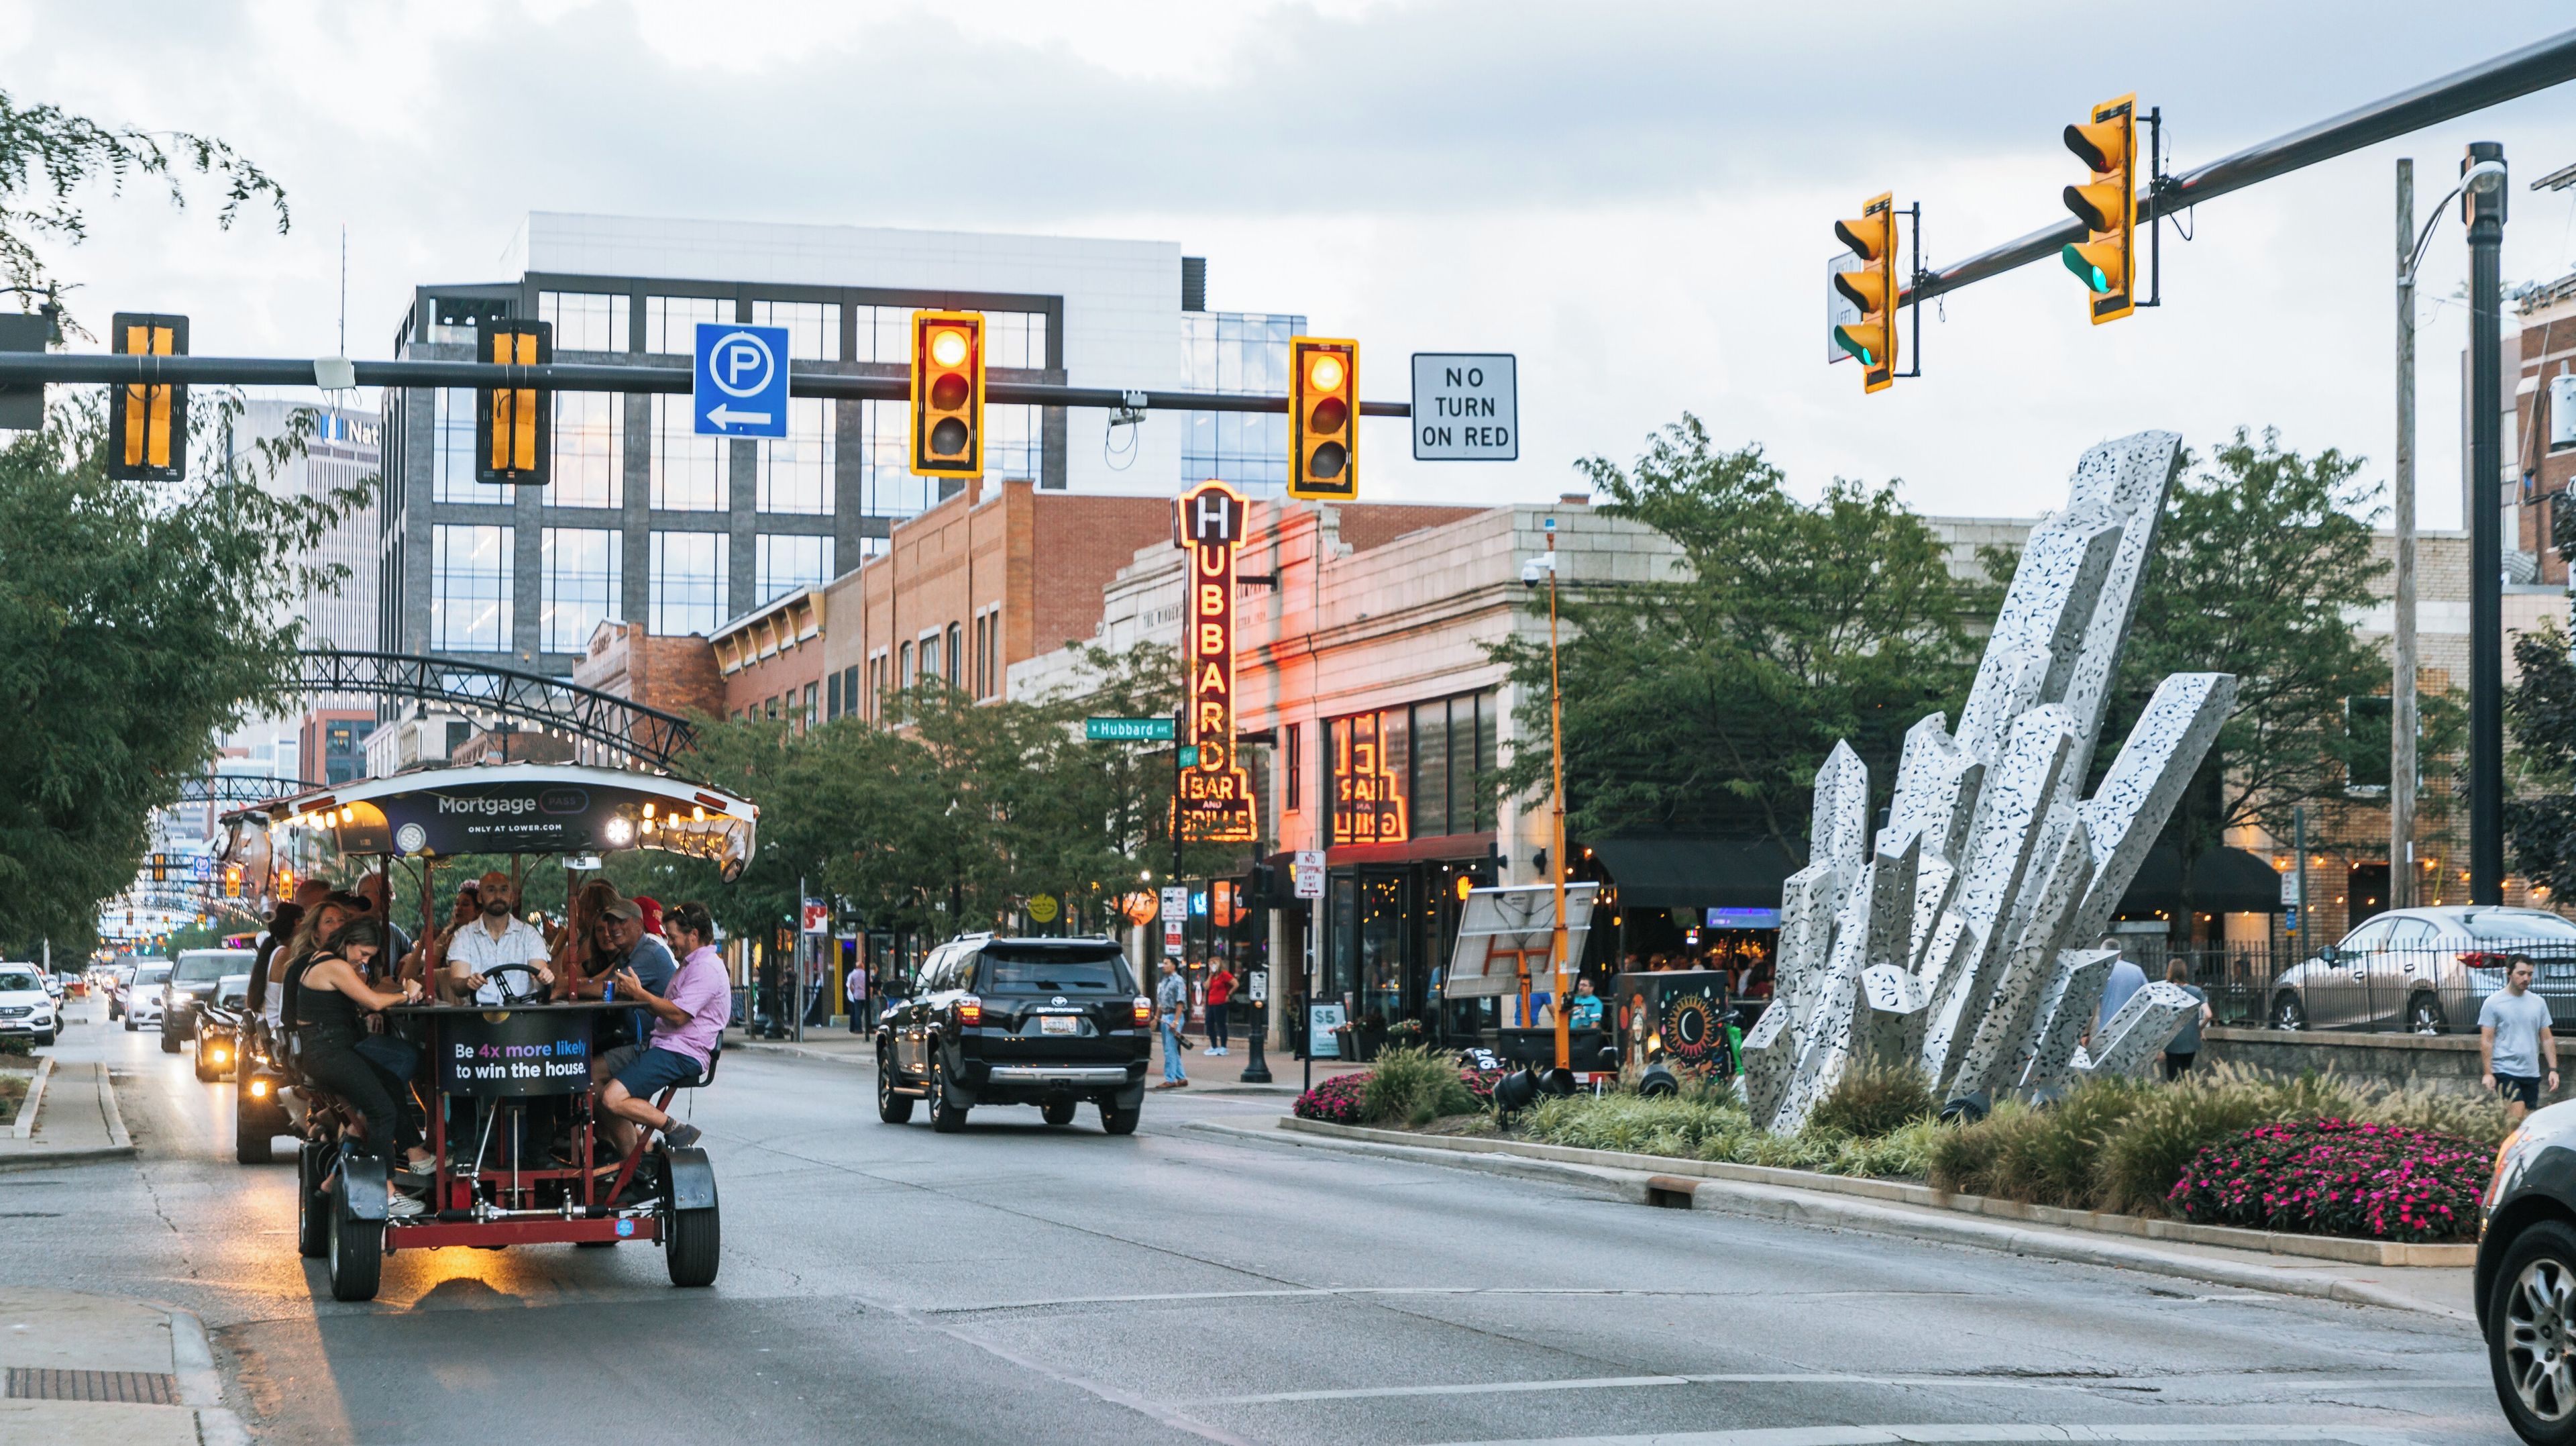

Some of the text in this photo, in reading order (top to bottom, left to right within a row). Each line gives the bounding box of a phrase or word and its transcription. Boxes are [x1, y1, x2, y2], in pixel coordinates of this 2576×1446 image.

[729, 345, 761, 385] P
[1446, 367, 1484, 388] NO
[1434, 397, 1495, 417] TURN
[348, 419, 379, 446] Nat
[1422, 425, 1509, 447] ON RED
[1196, 495, 1230, 772] HUBBARD
[1101, 722, 1154, 735] Hubbard
[1157, 725, 1168, 733] AVE
[1190, 776, 1234, 800] BAR
[438, 796, 577, 815] Mortgage PASS
[1202, 800, 1222, 809] AND
[468, 825, 492, 833] ONLY
[508, 823, 562, 832] LOWER.COM
[1297, 865, 1322, 874] STOPPING
[1305, 856, 1316, 864] NO
[1315, 1009, 1336, 1024] $5
[455, 1039, 586, 1058] Be 4x more likely
[455, 1060, 586, 1079] to win the house.
